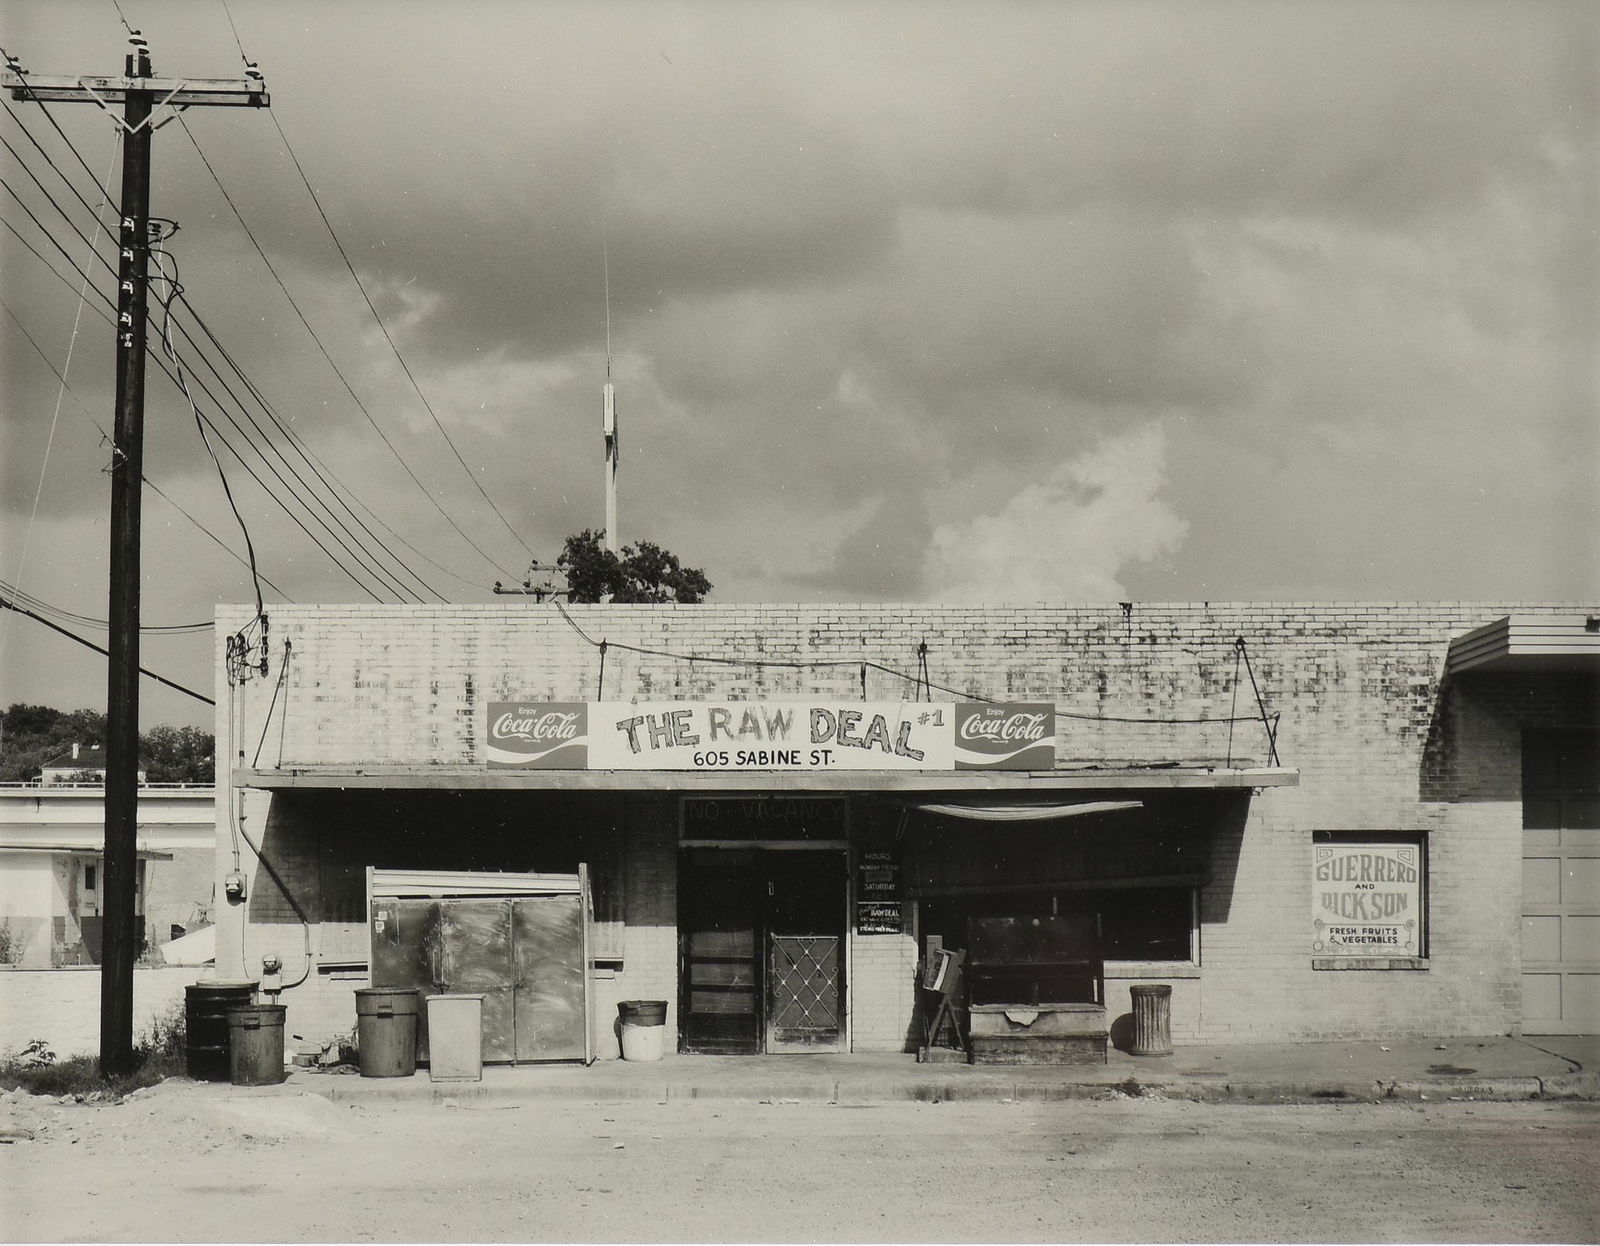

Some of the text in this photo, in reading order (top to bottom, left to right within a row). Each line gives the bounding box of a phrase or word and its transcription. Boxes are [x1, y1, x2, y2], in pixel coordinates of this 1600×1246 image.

[518, 707, 537, 716] Enjoy
[986, 708, 1005, 717] Enjoy
[492, 712, 581, 739] Coca-Cola
[616, 704, 945, 762] THE RAW DEAL #1
[960, 713, 1049, 741] Coca-Cola
[693, 749, 836, 767] 605 SABINE ST.
[1316, 854, 1417, 883] GUERRERO
[1320, 892, 1409, 921] DICKSON
[1329, 927, 1398, 936] FRESH FRUITS
[1329, 935, 1398, 946] & VEGETABLES
